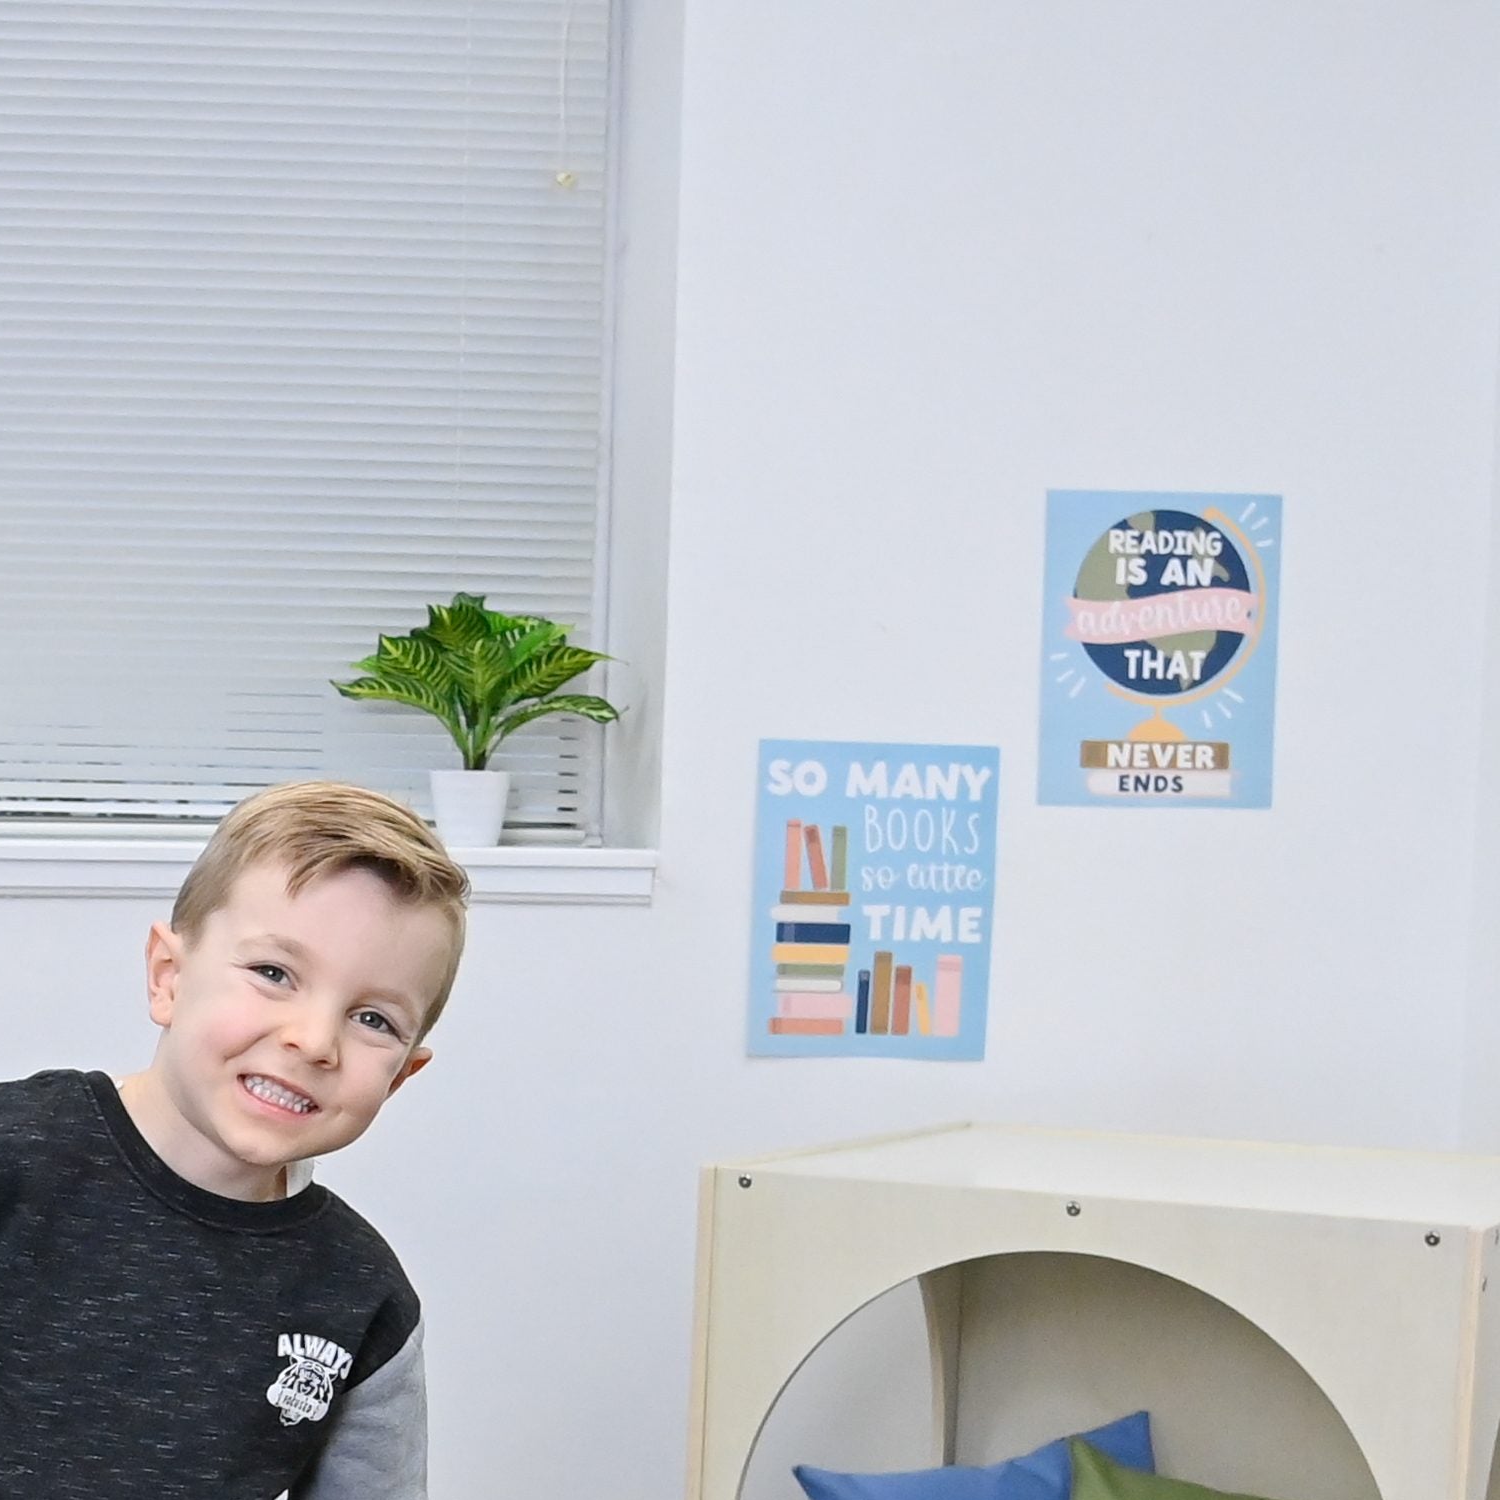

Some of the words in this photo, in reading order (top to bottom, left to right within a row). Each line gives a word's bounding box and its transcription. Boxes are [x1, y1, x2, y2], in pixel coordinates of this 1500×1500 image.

[1108, 528, 1222, 556] READING
[1115, 558, 1147, 586] IS
[1160, 558, 1214, 587] AN
[1075, 594, 1245, 636] adventure
[1124, 650, 1206, 680] THAT
[1106, 743, 1215, 769] NEVER
[766, 759, 828, 797] SO
[845, 761, 992, 801] MANY
[1118, 775, 1184, 793] ENDS
[864, 804, 980, 855] BOOKS
[860, 866, 898, 892] so
[906, 863, 986, 892] little
[862, 904, 982, 943] TIME
